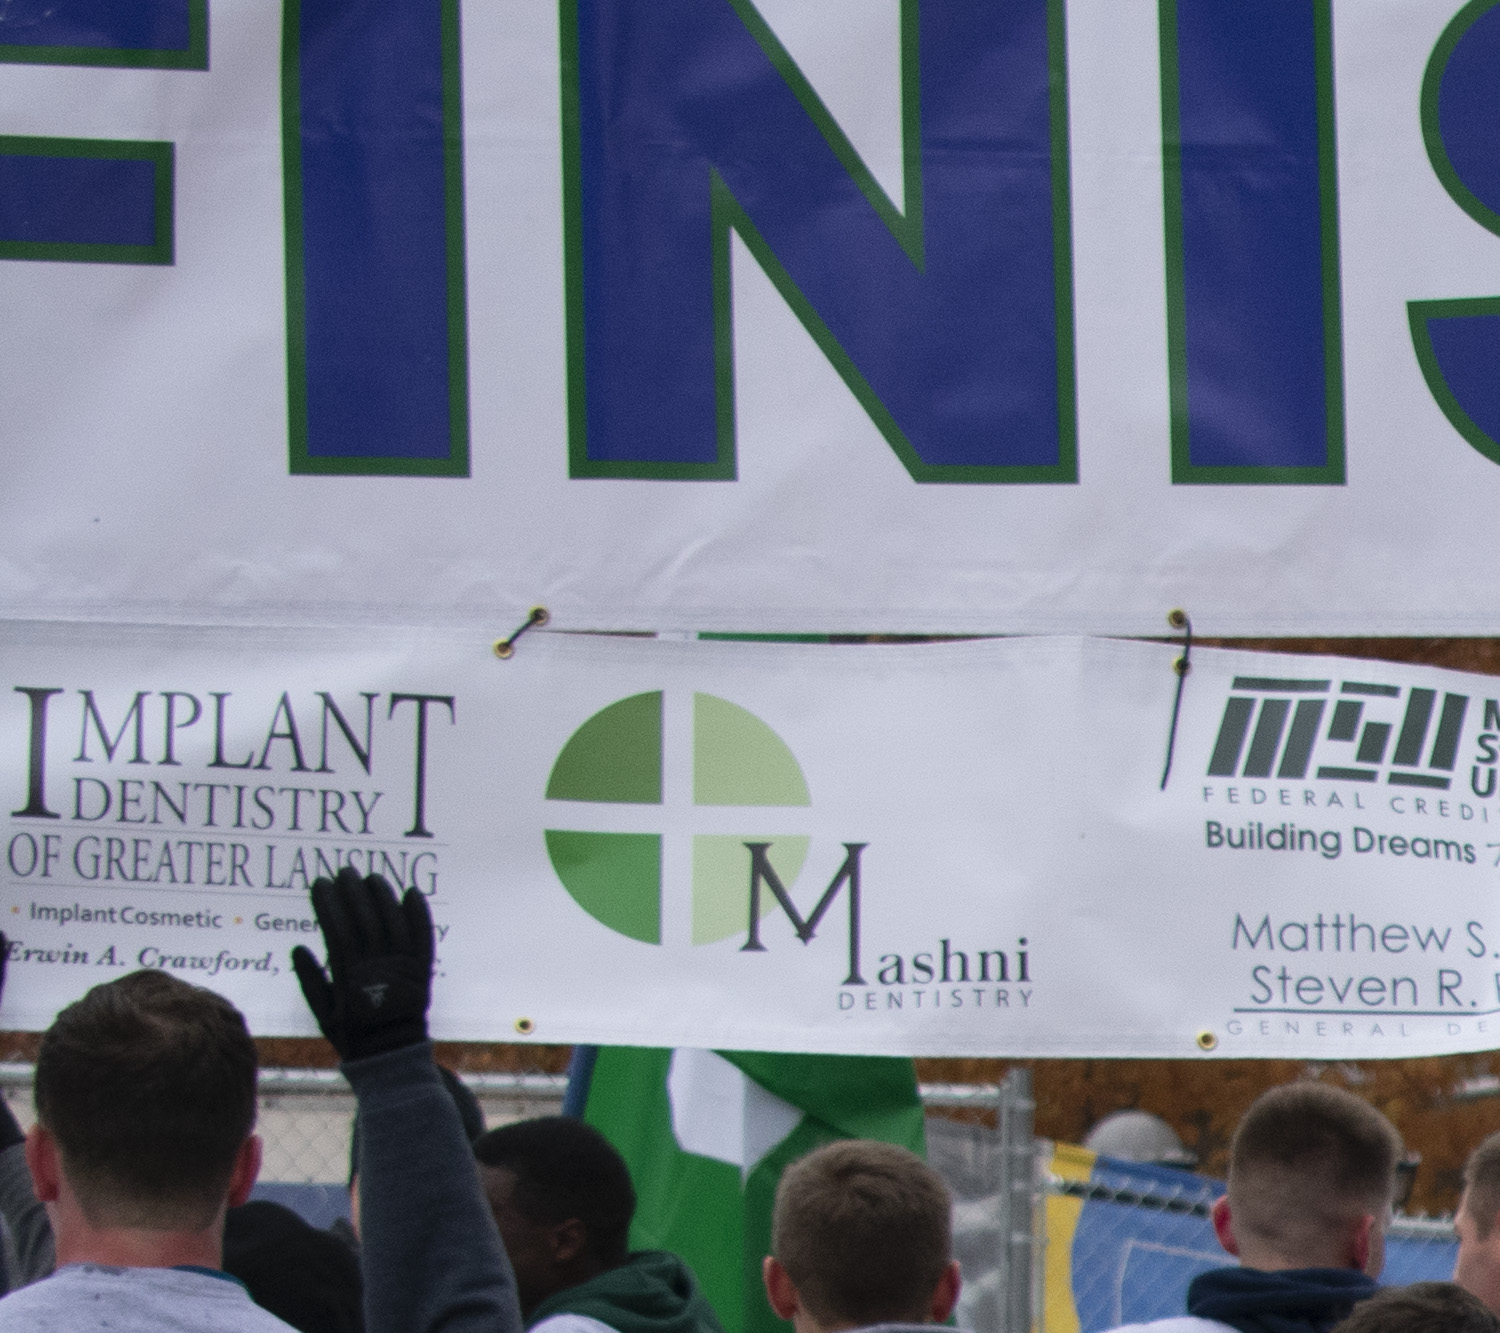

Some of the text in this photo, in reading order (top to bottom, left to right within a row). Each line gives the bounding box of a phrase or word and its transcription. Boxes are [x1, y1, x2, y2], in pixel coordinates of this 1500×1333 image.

[10, 685, 457, 839] IMPLANT
[71, 776, 386, 836] DENTISTRY
[1202, 786, 1367, 809] FEDERAL
[7, 832, 62, 878] OF
[72, 834, 255, 888] GREATER
[1206, 820, 1342, 860] Building
[1352, 827, 1478, 865] Dreams
[738, 841, 1034, 987] Mashni
[1231, 911, 1452, 953] Matthew
[6, 941, 280, 977] Erwin A. Crawford,
[838, 988, 1035, 1011] DENTISTRY
[1250, 964, 1419, 1008] Steven
[1436, 968, 1479, 1009] R.
[1224, 1017, 1412, 1038] GENERAL
